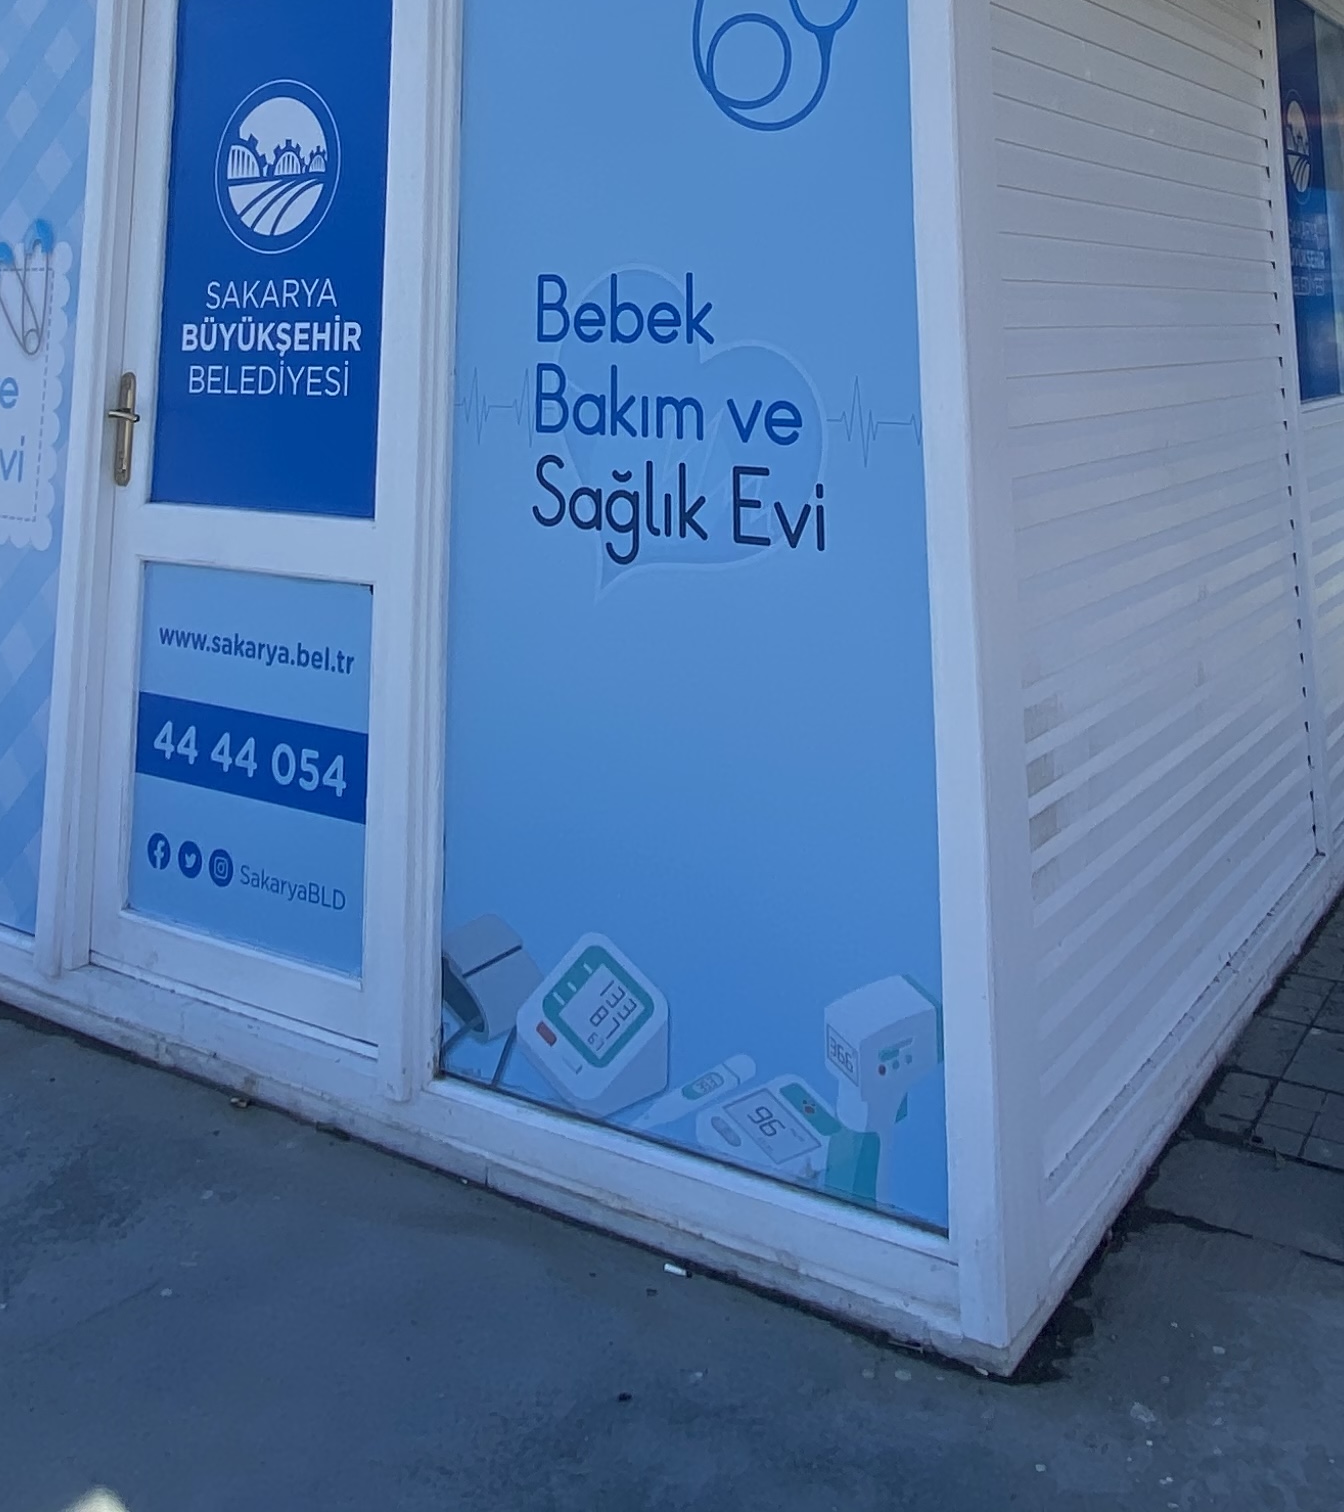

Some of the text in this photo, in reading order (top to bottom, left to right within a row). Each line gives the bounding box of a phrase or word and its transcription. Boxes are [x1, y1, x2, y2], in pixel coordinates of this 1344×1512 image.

[205, 277, 338, 310] SAKARYA
[537, 272, 715, 345] Bebek
[181, 314, 362, 357] BÜYÜKŞEHİR
[188, 360, 350, 397] BELEDİYESİ
[535, 363, 803, 446] Bakım ve
[532, 454, 826, 565] Sağlık Evi
[159, 626, 355, 675] www.sakarya.bel.tr
[154, 721, 347, 797] 44 44 054
[239, 865, 347, 911] SakaryaBLD
